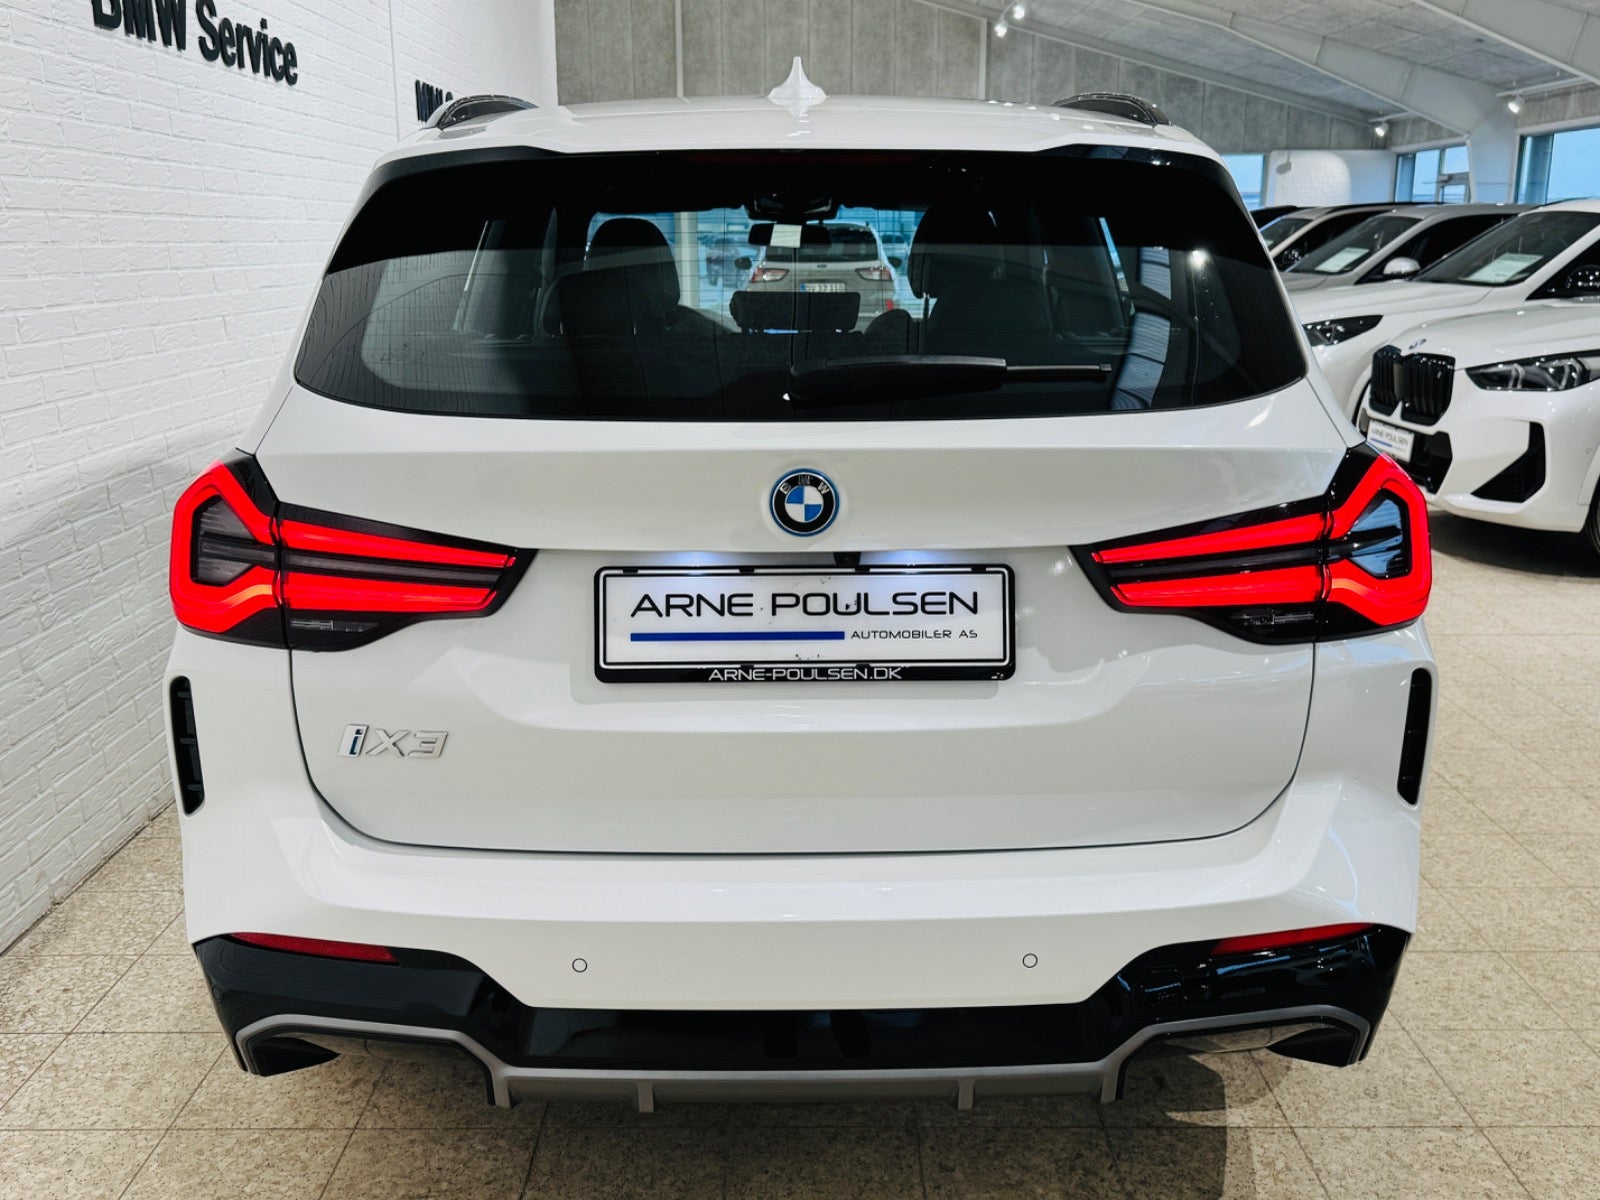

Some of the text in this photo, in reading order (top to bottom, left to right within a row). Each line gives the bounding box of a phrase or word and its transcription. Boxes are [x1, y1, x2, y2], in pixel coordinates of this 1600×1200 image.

[196, 0, 298, 86] Service
[780, 474, 830, 495] BMW
[630, 591, 978, 618] ARNE POULSEN
[850, 629, 978, 640] AUTOMOBILER AS
[708, 667, 902, 681] ARNE-POULSEN.DK
